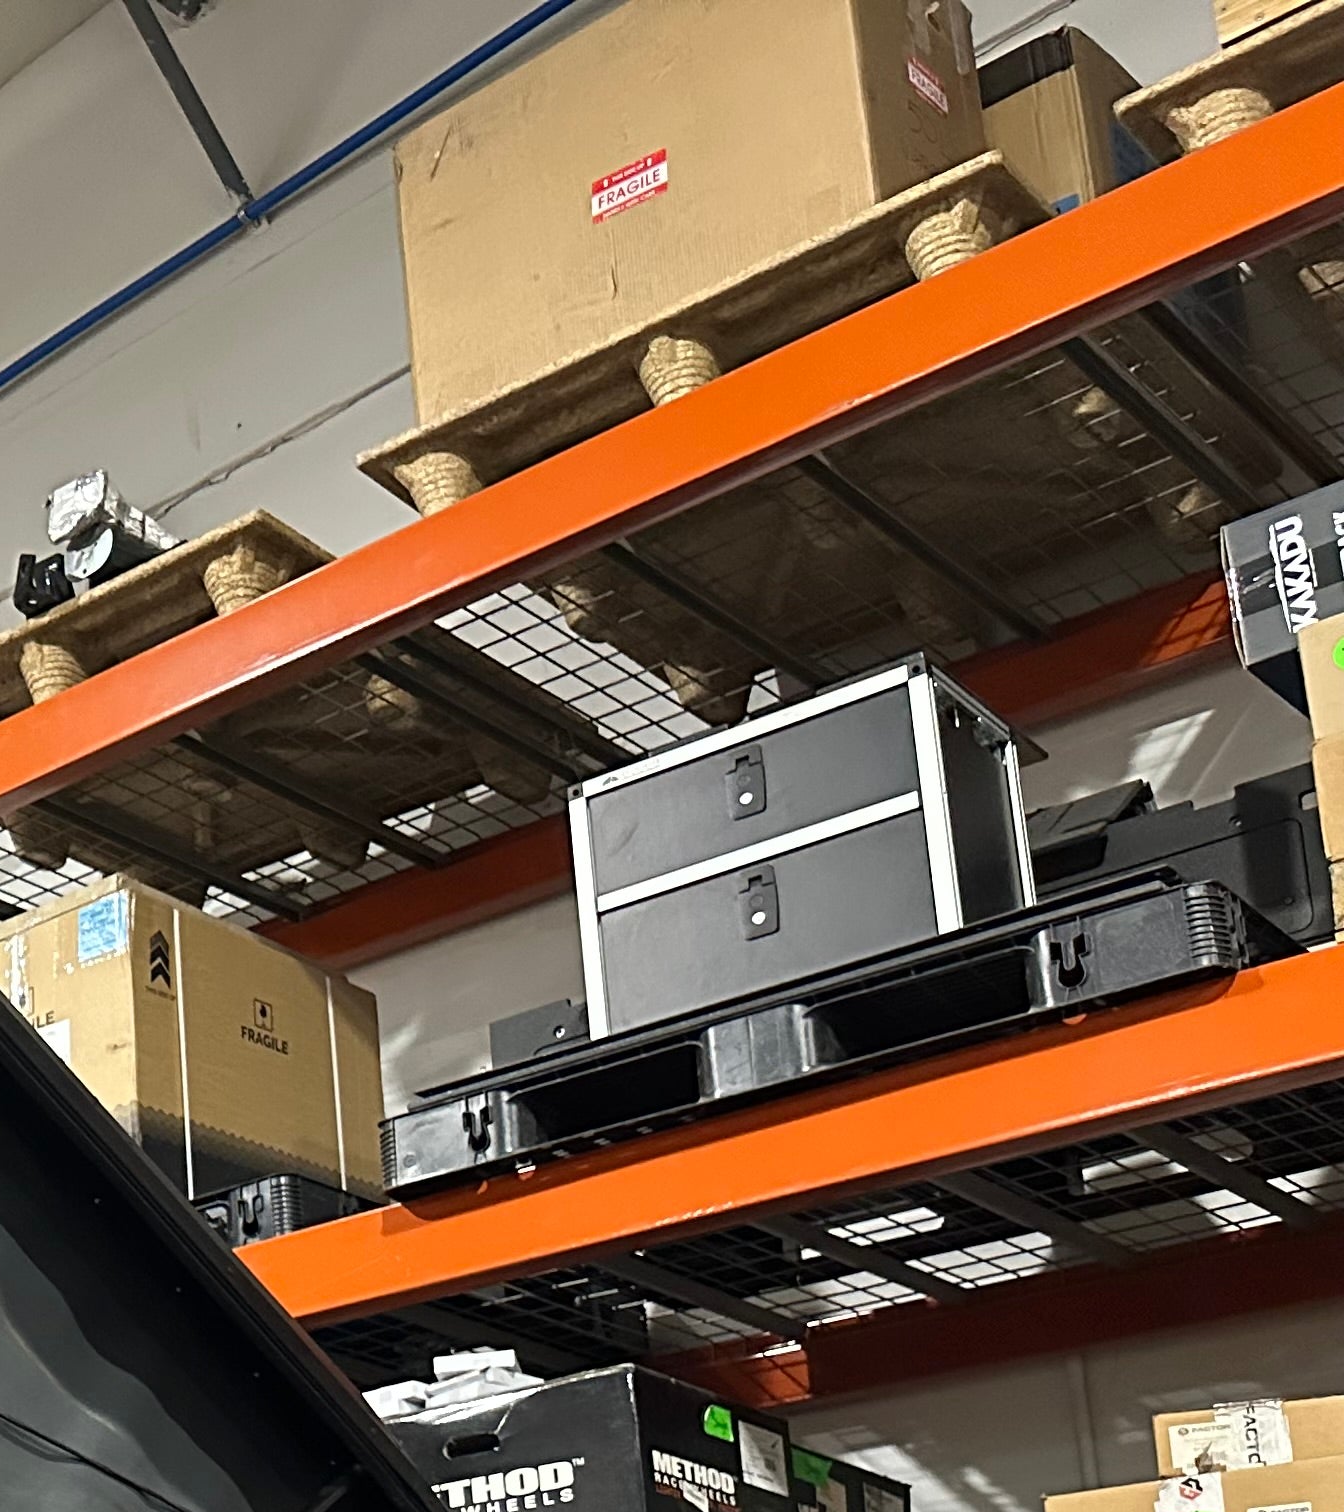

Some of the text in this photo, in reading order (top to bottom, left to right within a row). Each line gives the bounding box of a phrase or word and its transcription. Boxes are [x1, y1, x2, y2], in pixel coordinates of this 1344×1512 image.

[598, 168, 660, 209] FRAGILE
[240, 1024, 289, 1055] FRAGILE
[431, 1460, 575, 1509] THOD
[652, 1449, 737, 1495] METHOD
